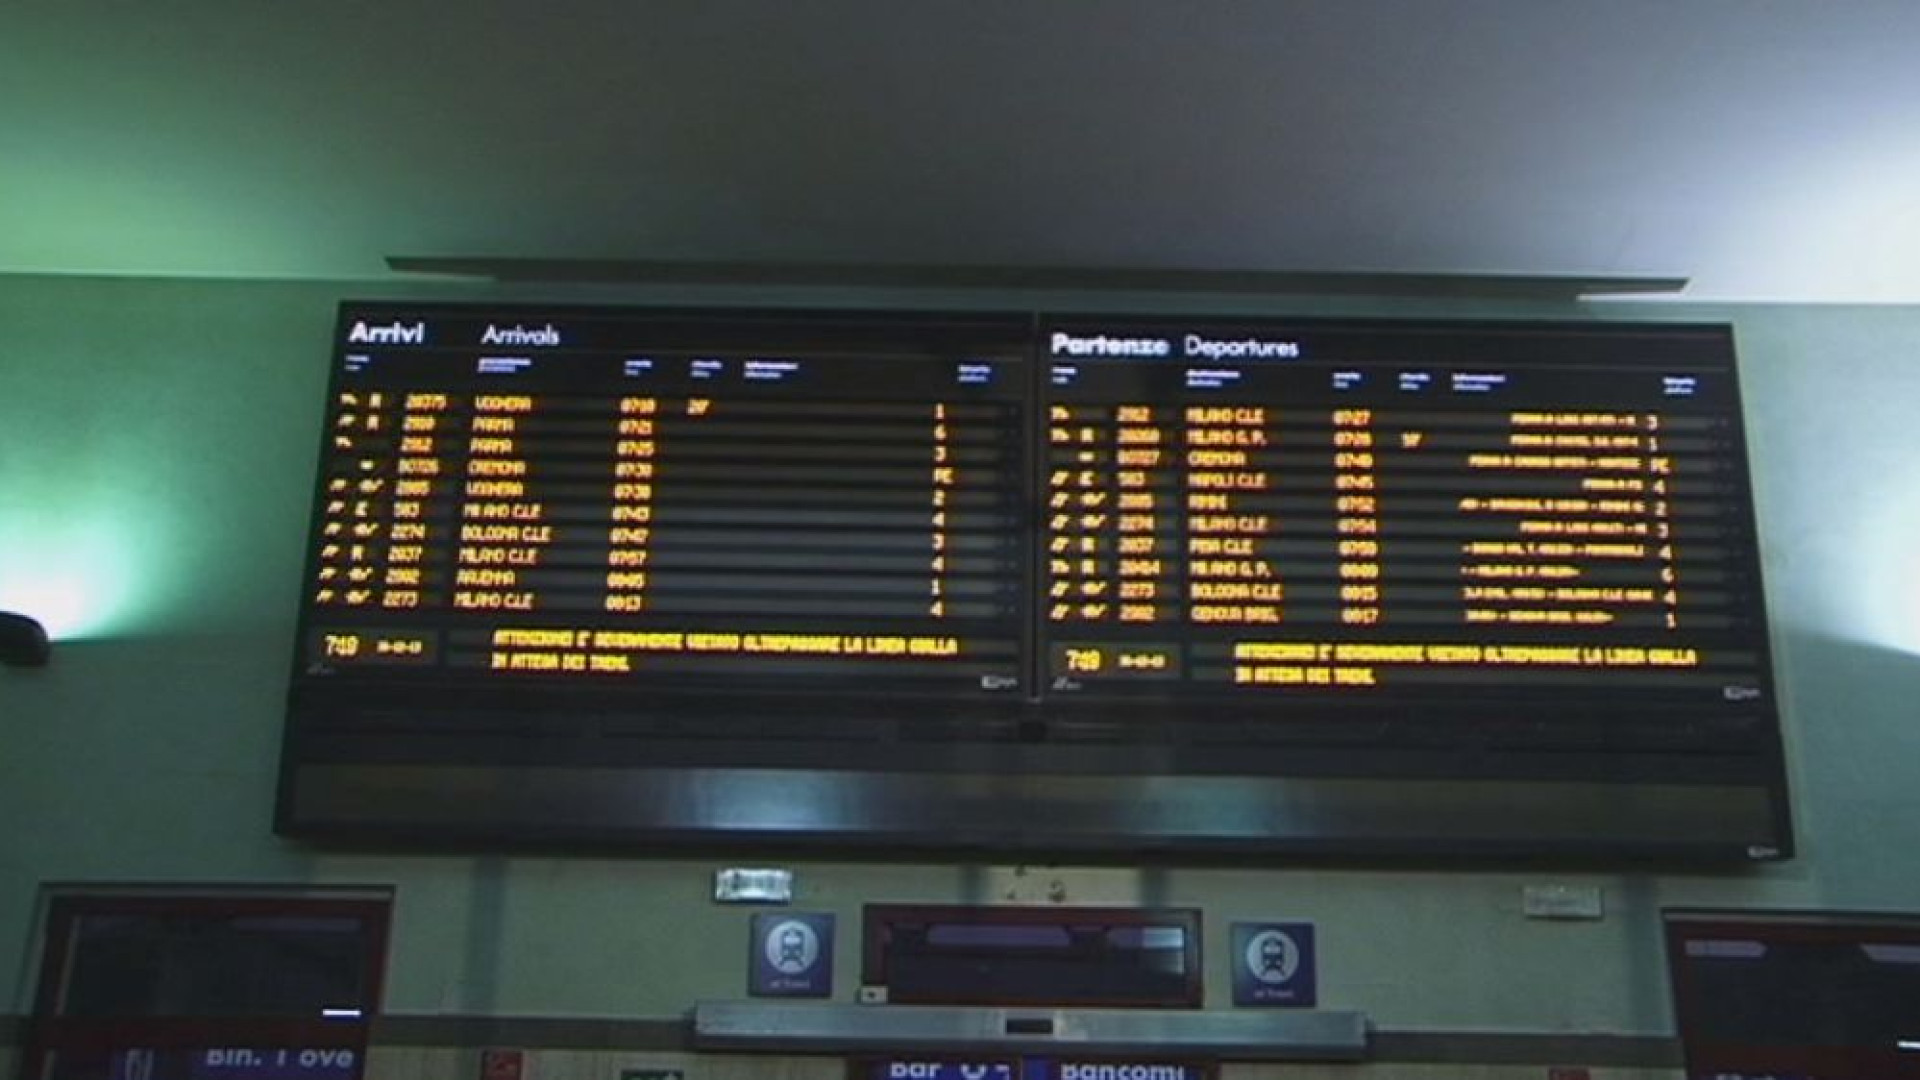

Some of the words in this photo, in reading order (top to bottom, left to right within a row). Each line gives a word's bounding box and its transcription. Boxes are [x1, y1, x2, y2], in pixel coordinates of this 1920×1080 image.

[350, 323, 423, 342] Arrivi
[482, 325, 559, 344] Arrivals
[1052, 333, 1169, 355] Partenze
[1186, 336, 1299, 359] Departures
